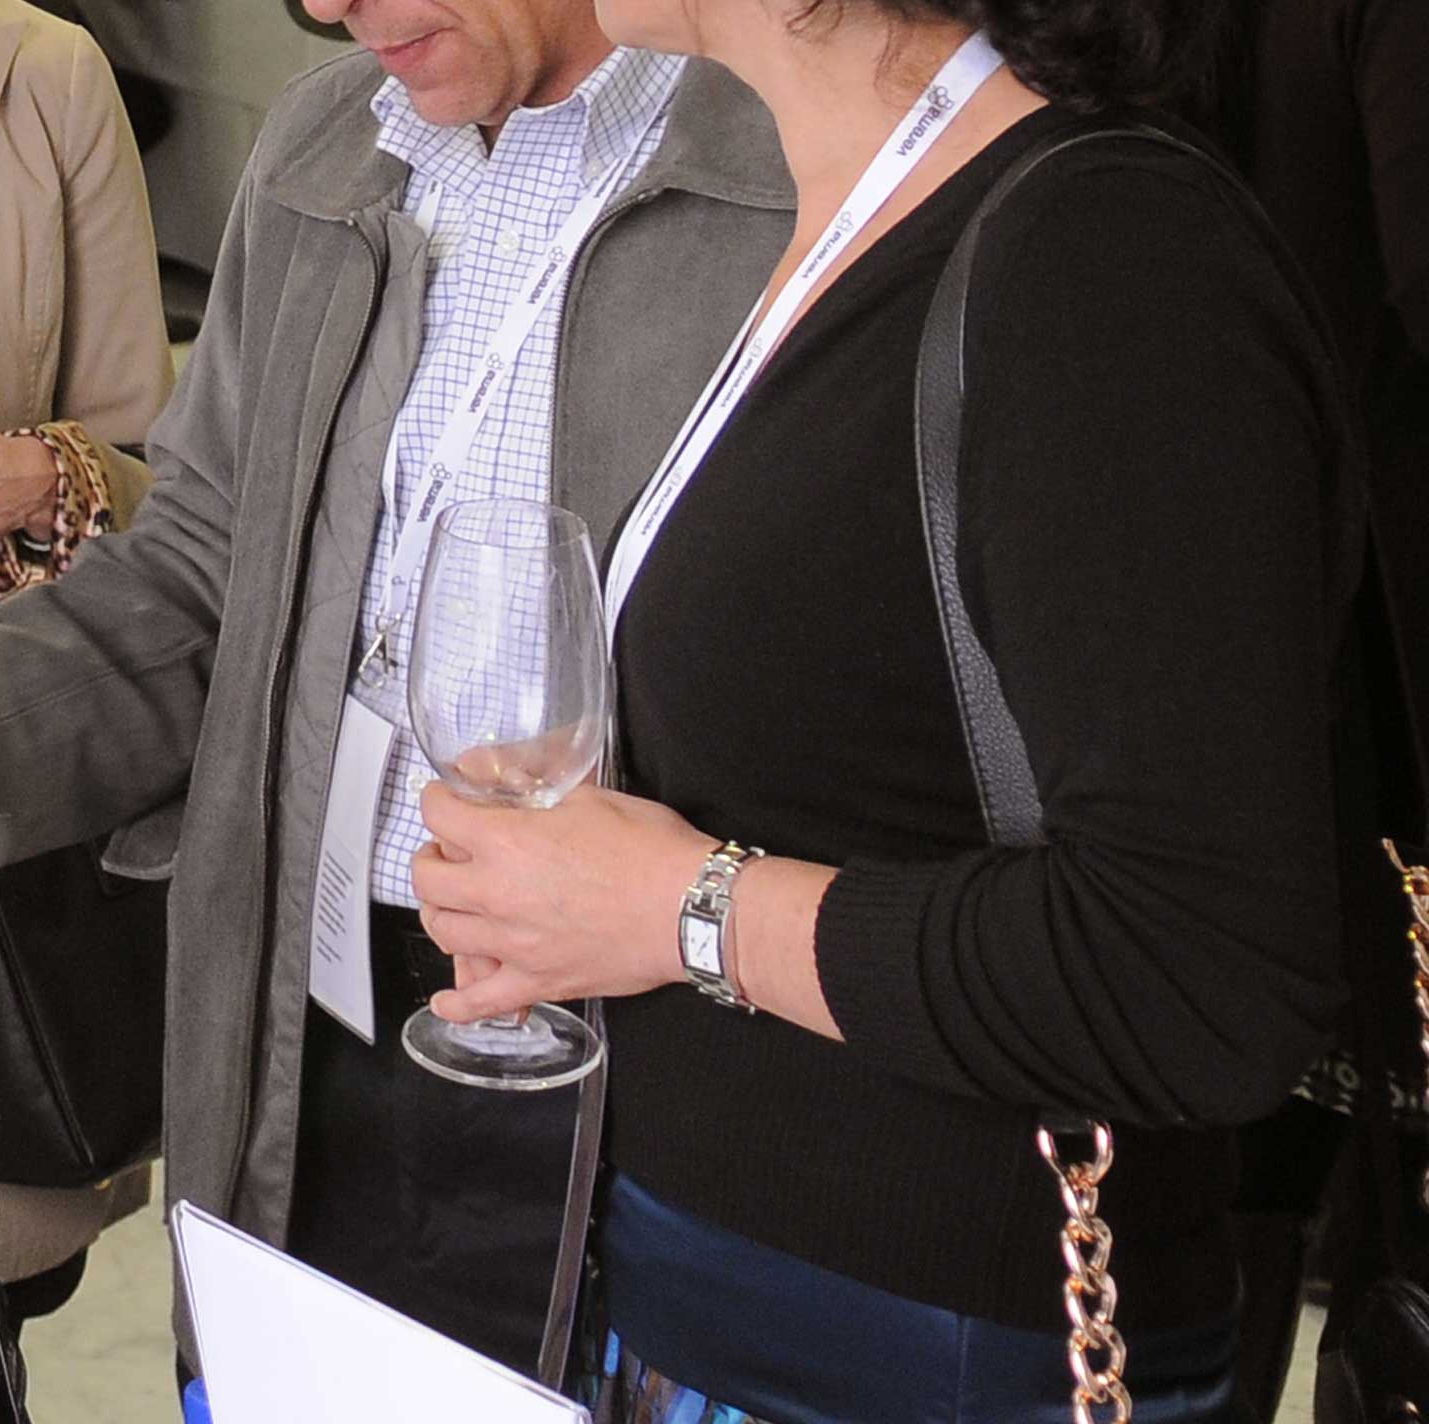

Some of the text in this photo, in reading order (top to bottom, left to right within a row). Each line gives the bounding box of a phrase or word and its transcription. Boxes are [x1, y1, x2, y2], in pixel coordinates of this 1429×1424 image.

[896, 102, 941, 158] verema
[527, 261, 559, 305] verema
[468, 369, 496, 414] verema
[417, 479, 444, 523] verema
